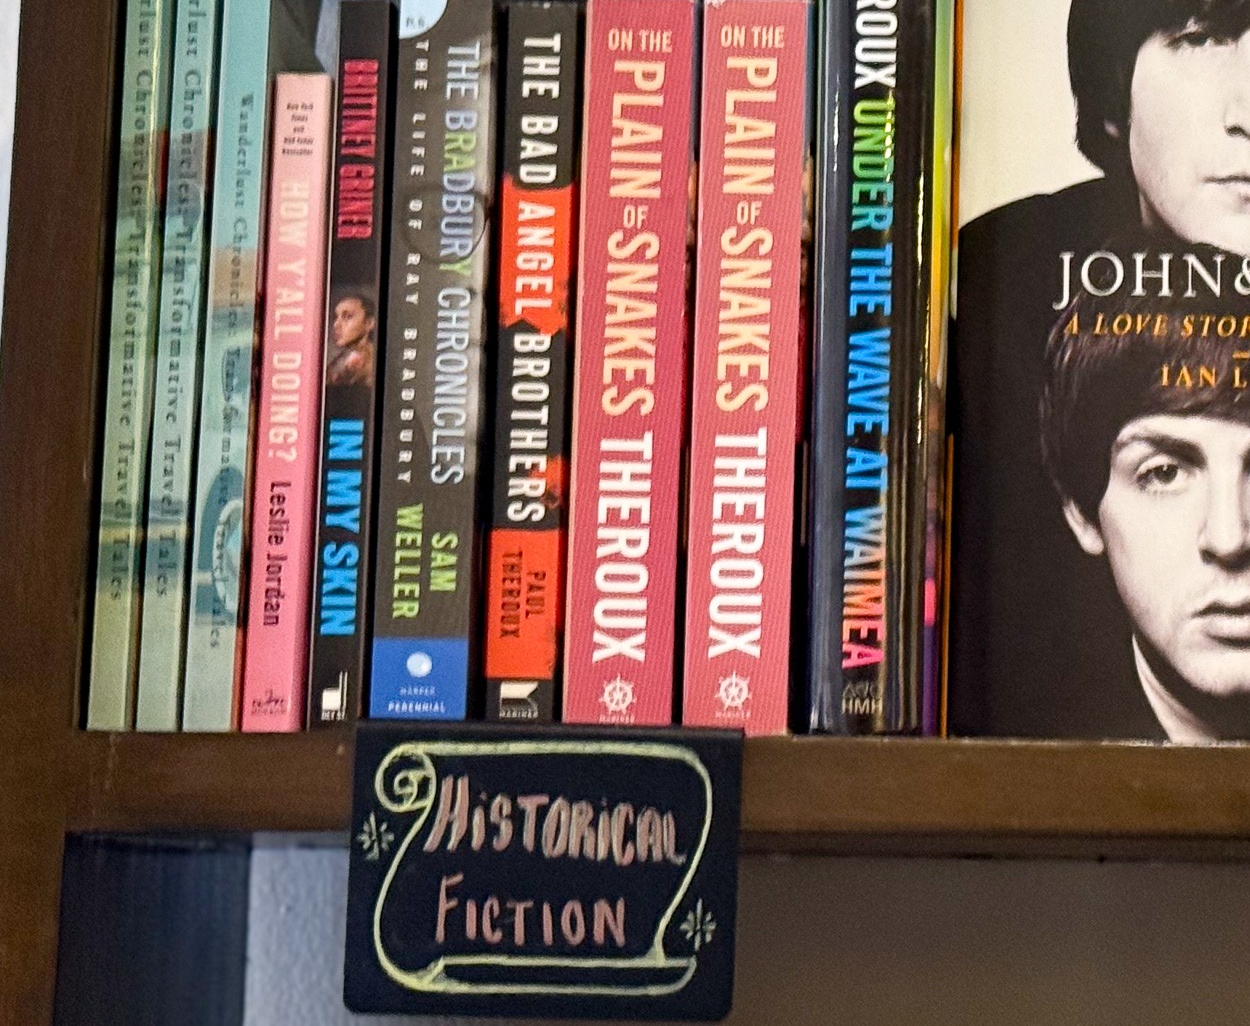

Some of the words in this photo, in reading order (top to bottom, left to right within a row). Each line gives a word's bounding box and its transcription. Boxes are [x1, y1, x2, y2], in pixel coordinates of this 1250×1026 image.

[413, 39, 429, 93] THE
[445, 42, 482, 102] THE
[521, 33, 562, 100] THE
[608, 28, 635, 53] ON
[638, 29, 674, 54] THE
[720, 24, 748, 49] ON
[751, 24, 786, 50] THE
[340, 58, 379, 158] BRITTNEY
[410, 112, 427, 177] LIFE
[609, 59, 667, 200] PLAIN
[722, 56, 779, 196] PLAIN
[233, 93, 255, 208] Wanderlust
[518, 113, 560, 186] BAD
[851, 98, 897, 233] UNDER
[277, 177, 310, 247] HOW
[337, 164, 376, 240] GRINER
[408, 199, 424, 231] OF
[437, 109, 478, 277] BRADBURY
[622, 204, 649, 230] OF
[736, 199, 763, 225] OF
[405, 253, 422, 307] RAY
[514, 200, 557, 317] ANGEL
[849, 242, 894, 317] THE
[600, 229, 661, 418] SNAKES
[715, 224, 775, 413] SNAKES
[1064, 316, 1080, 336] A
[1093, 314, 1169, 338] LOVE
[267, 350, 303, 463] DOING?
[397, 328, 419, 484] BRADBURY
[430, 286, 472, 486] CHRONICLES
[846, 327, 892, 437] WAVE
[1159, 364, 1219, 389] IAN
[327, 418, 364, 462] IN
[507, 332, 553, 524] BROTHERS
[115, 438, 136, 518] Travel
[160, 437, 182, 516] Travel
[325, 469, 363, 535] MY
[845, 443, 889, 491] AT
[267, 479, 293, 547] Leslie
[591, 429, 654, 665] THEROUX
[706, 426, 768, 661] THEROUX
[109, 531, 129, 602] Tales
[155, 529, 177, 599] Tales
[262, 553, 289, 627] Jordan
[319, 541, 360, 637] SKIN
[391, 502, 424, 620] WELLER
[429, 532, 459, 593] SAM
[500, 548, 524, 640] THEROUX
[525, 570, 548, 621] PAUL
[841, 505, 888, 671] WAIMEA
[434, 872, 627, 948] FICTION
